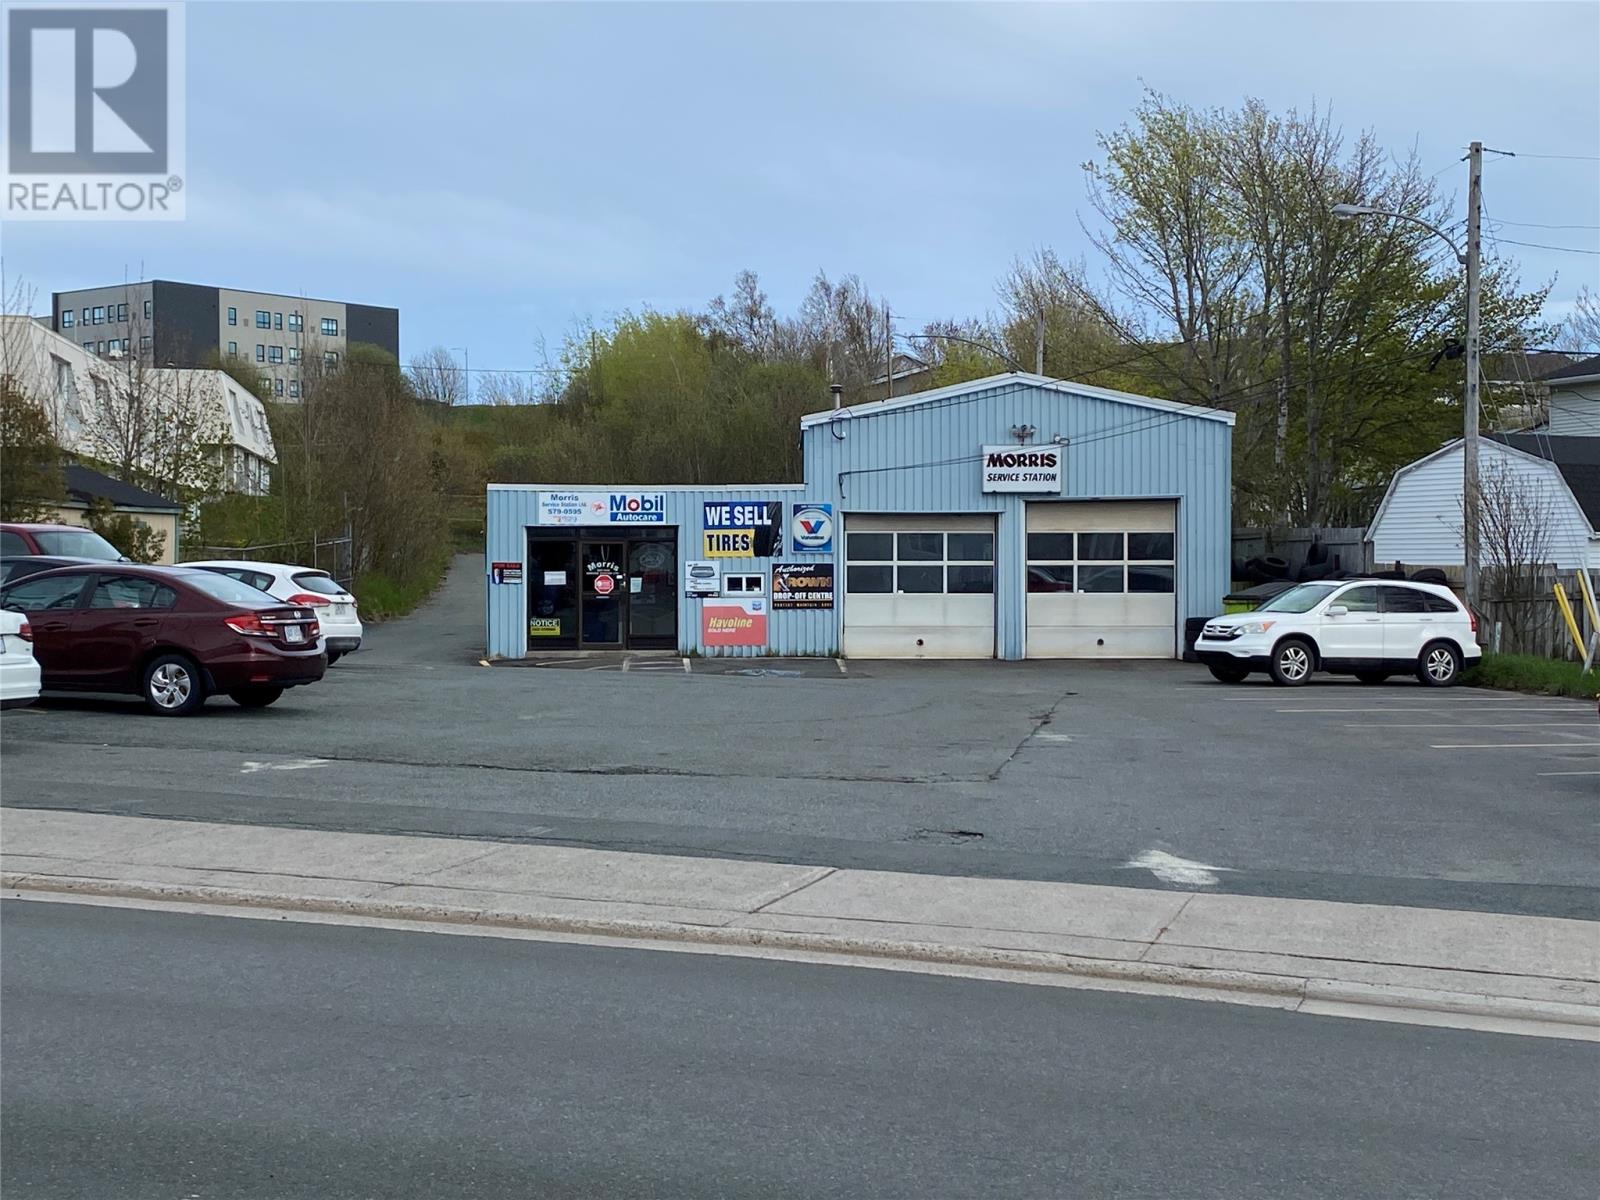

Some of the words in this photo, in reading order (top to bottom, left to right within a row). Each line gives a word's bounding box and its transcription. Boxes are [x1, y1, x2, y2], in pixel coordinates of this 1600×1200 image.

[986, 453, 1057, 468] MORRIS
[987, 473, 1019, 482] SERVICE
[1022, 473, 1057, 482] STATION
[610, 495, 664, 511] Mobil
[616, 512, 657, 521] Autocare
[705, 506, 730, 526] WE
[734, 505, 772, 526] SELL
[707, 534, 750, 552] TIRES
[587, 561, 620, 572] Morris
[774, 565, 815, 573] Authorized
[773, 592, 807, 600] DROP-OFF
[808, 592, 833, 600] CENTRE
[709, 617, 753, 628] Havoline
